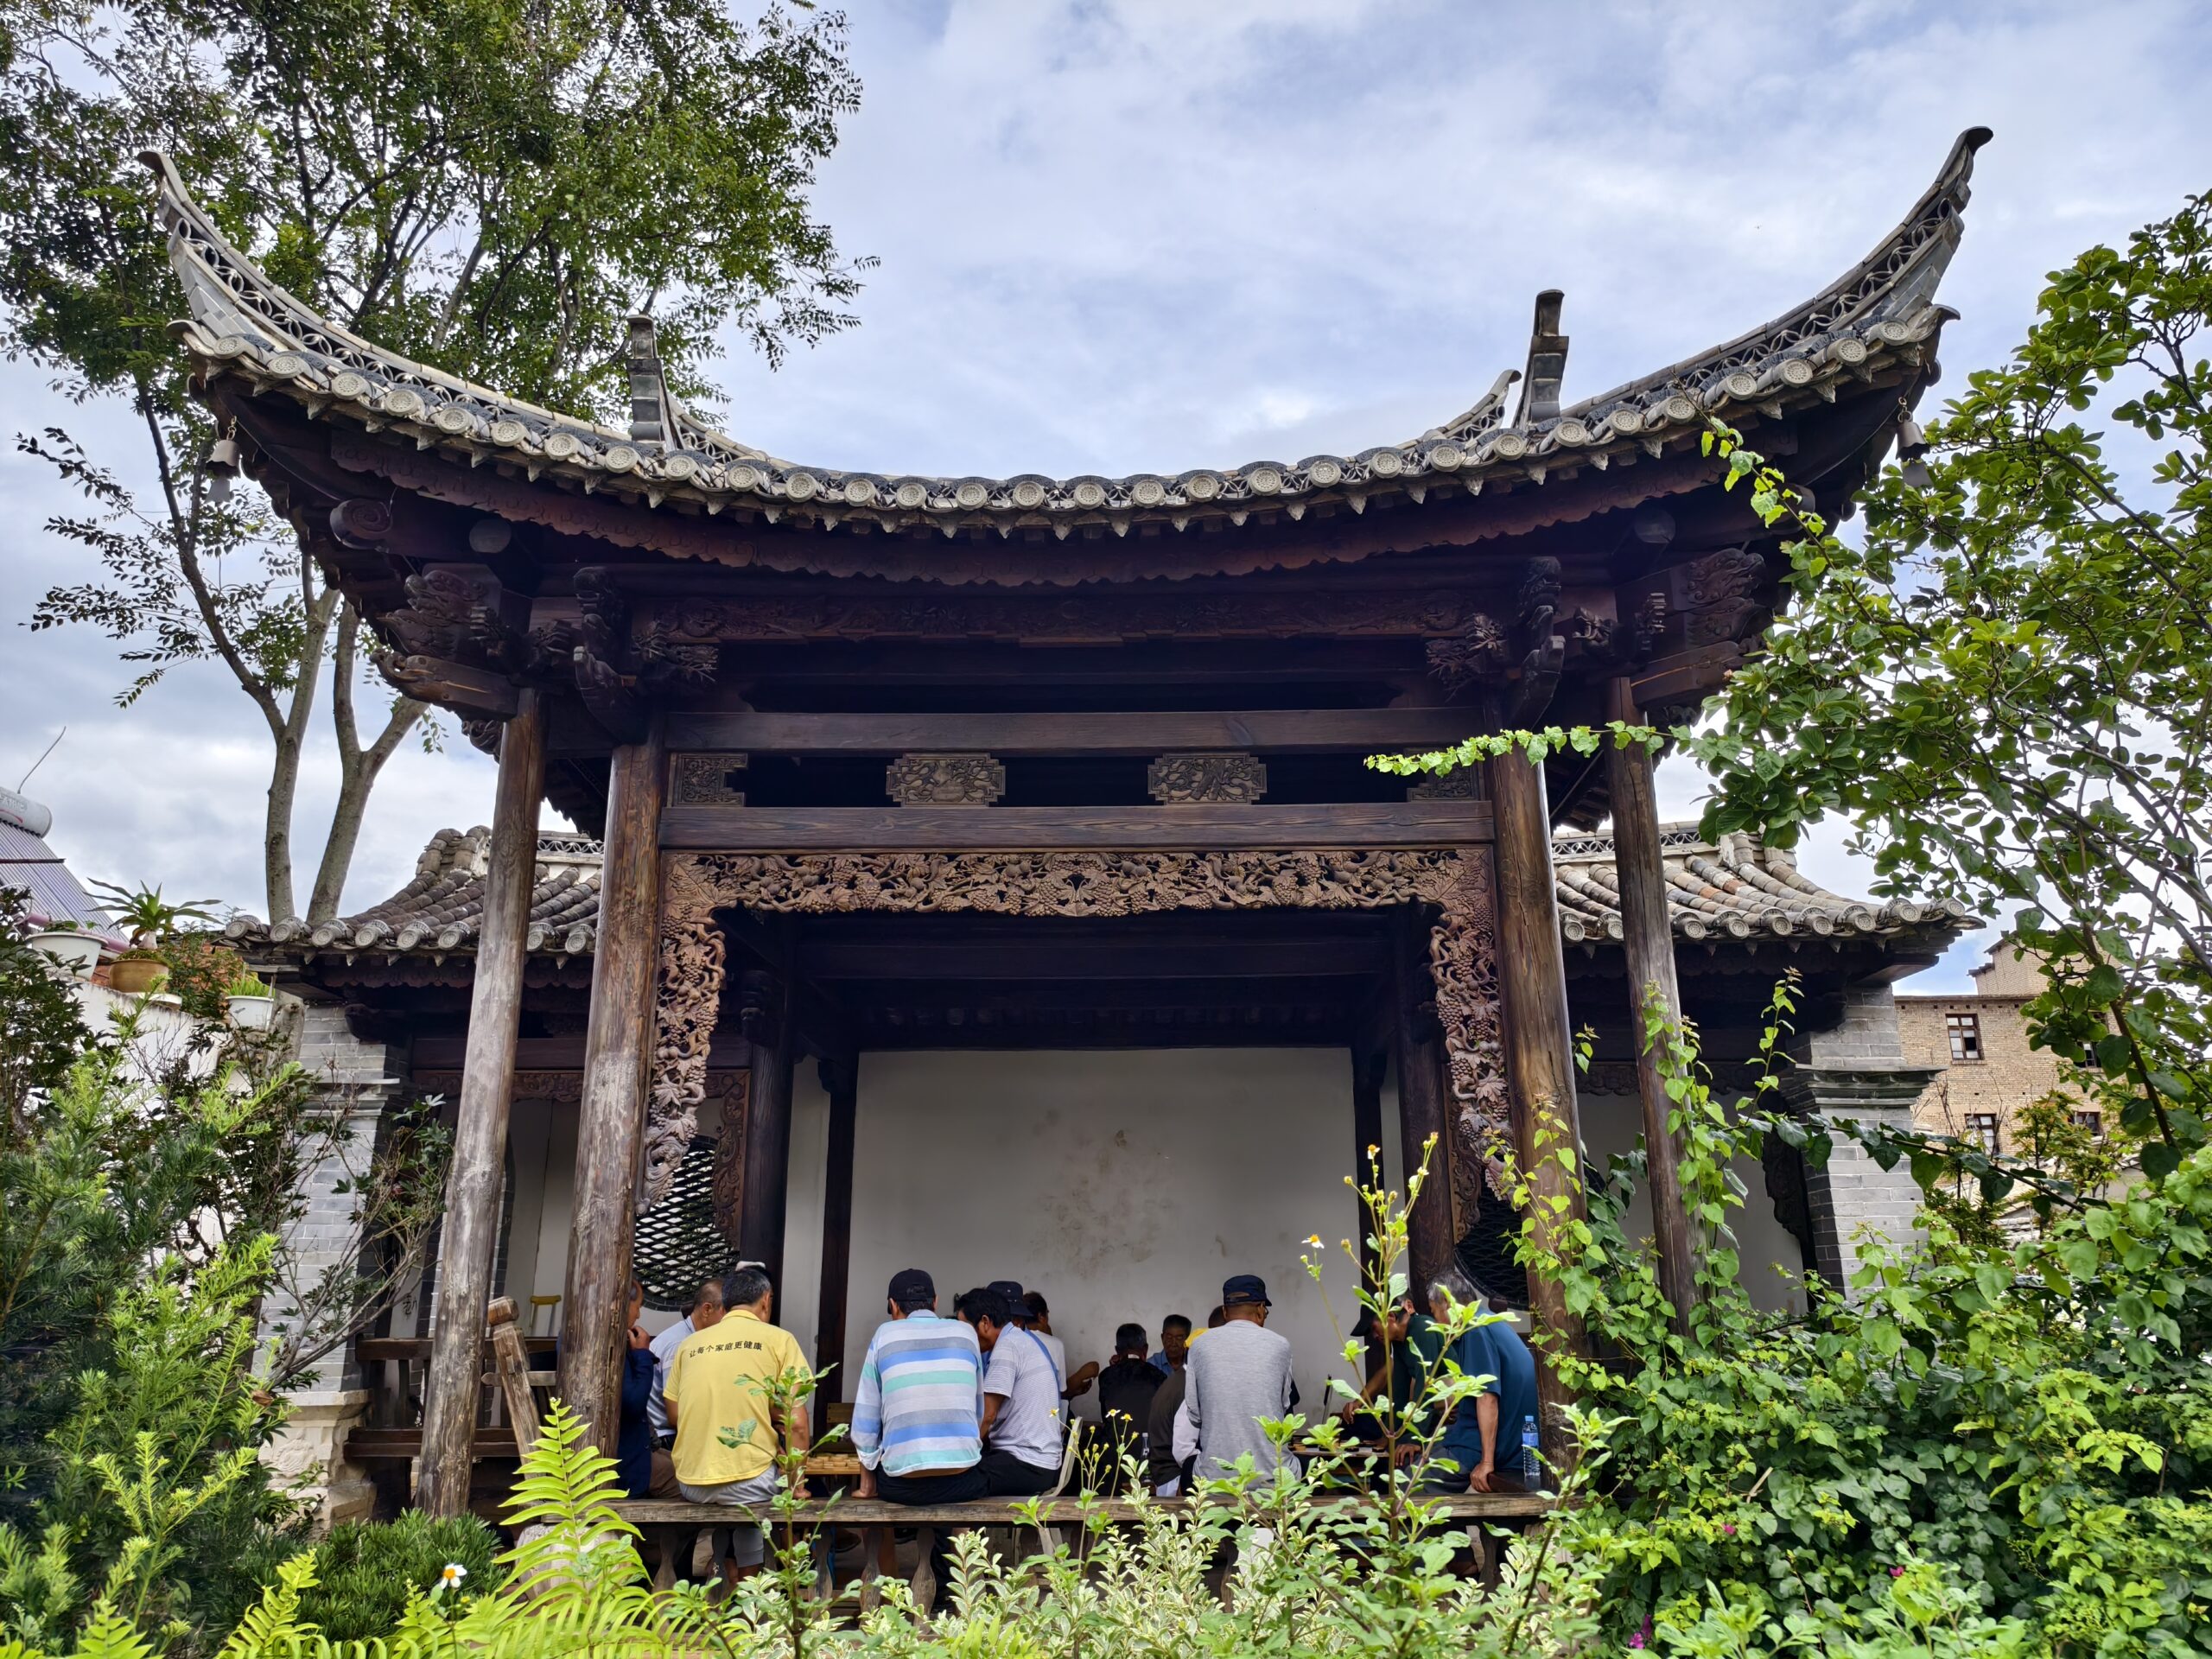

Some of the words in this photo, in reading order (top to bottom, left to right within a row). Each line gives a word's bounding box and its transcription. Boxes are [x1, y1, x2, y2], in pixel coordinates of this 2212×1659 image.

[690, 1340, 762, 1358] 让每个家庭更健康
